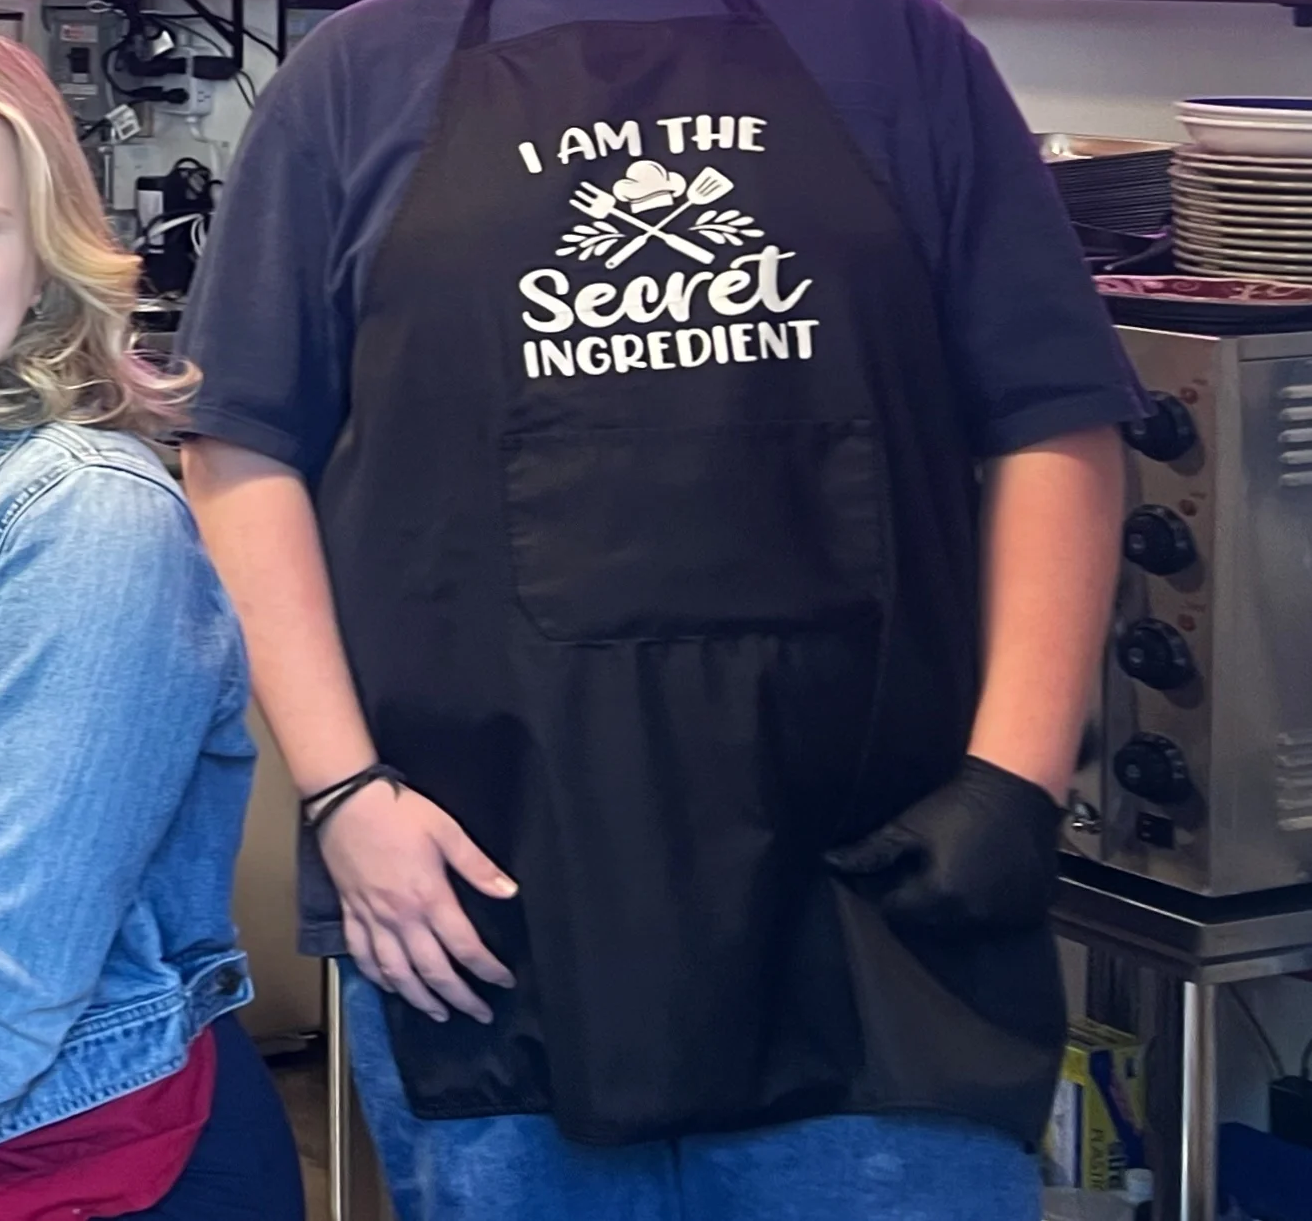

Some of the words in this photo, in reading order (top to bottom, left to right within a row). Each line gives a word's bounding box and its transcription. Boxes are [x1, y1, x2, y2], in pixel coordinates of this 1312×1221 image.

[518, 141, 543, 174] I
[557, 120, 643, 165] AM
[656, 114, 768, 154] THE
[518, 245, 813, 333] Secret
[523, 319, 820, 379] INGREDIENT
